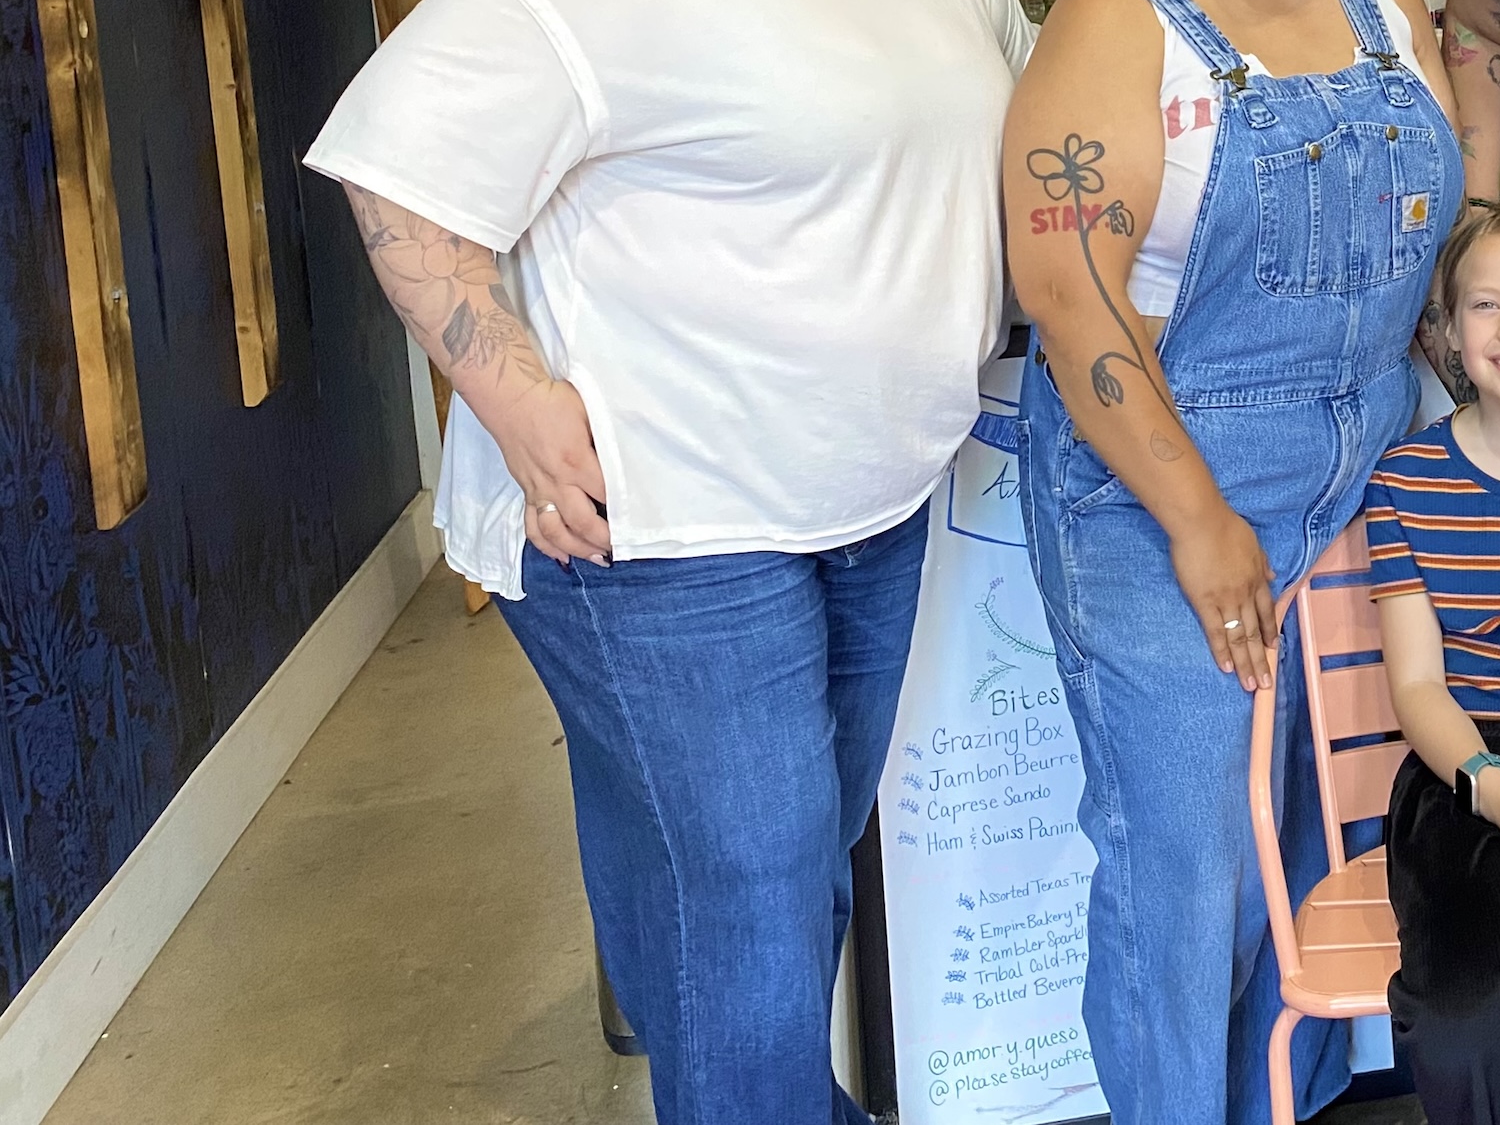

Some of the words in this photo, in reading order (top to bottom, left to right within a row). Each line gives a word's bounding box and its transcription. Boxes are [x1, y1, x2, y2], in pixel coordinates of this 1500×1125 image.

[988, 686, 1060, 716] Bites
[932, 727, 1019, 756] Grazing
[1025, 717, 1064, 747] Box
[929, 763, 1009, 792] Jambon
[1014, 753, 1080, 776] Beurre
[927, 800, 999, 824] Caprese
[1003, 784, 1051, 807] Sando
[927, 832, 963, 856] Ham
[982, 824, 1024, 846] Swiss
[1029, 816, 1079, 841] Panini
[980, 882, 1030, 907] Assorted
[1031, 878, 1070, 894] Texas
[980, 920, 1026, 939] Empire
[1027, 910, 1073, 928] Bakery
[980, 939, 1045, 964] Rambler
[974, 961, 1023, 985] Tribal
[973, 984, 1027, 1009] Bottled
